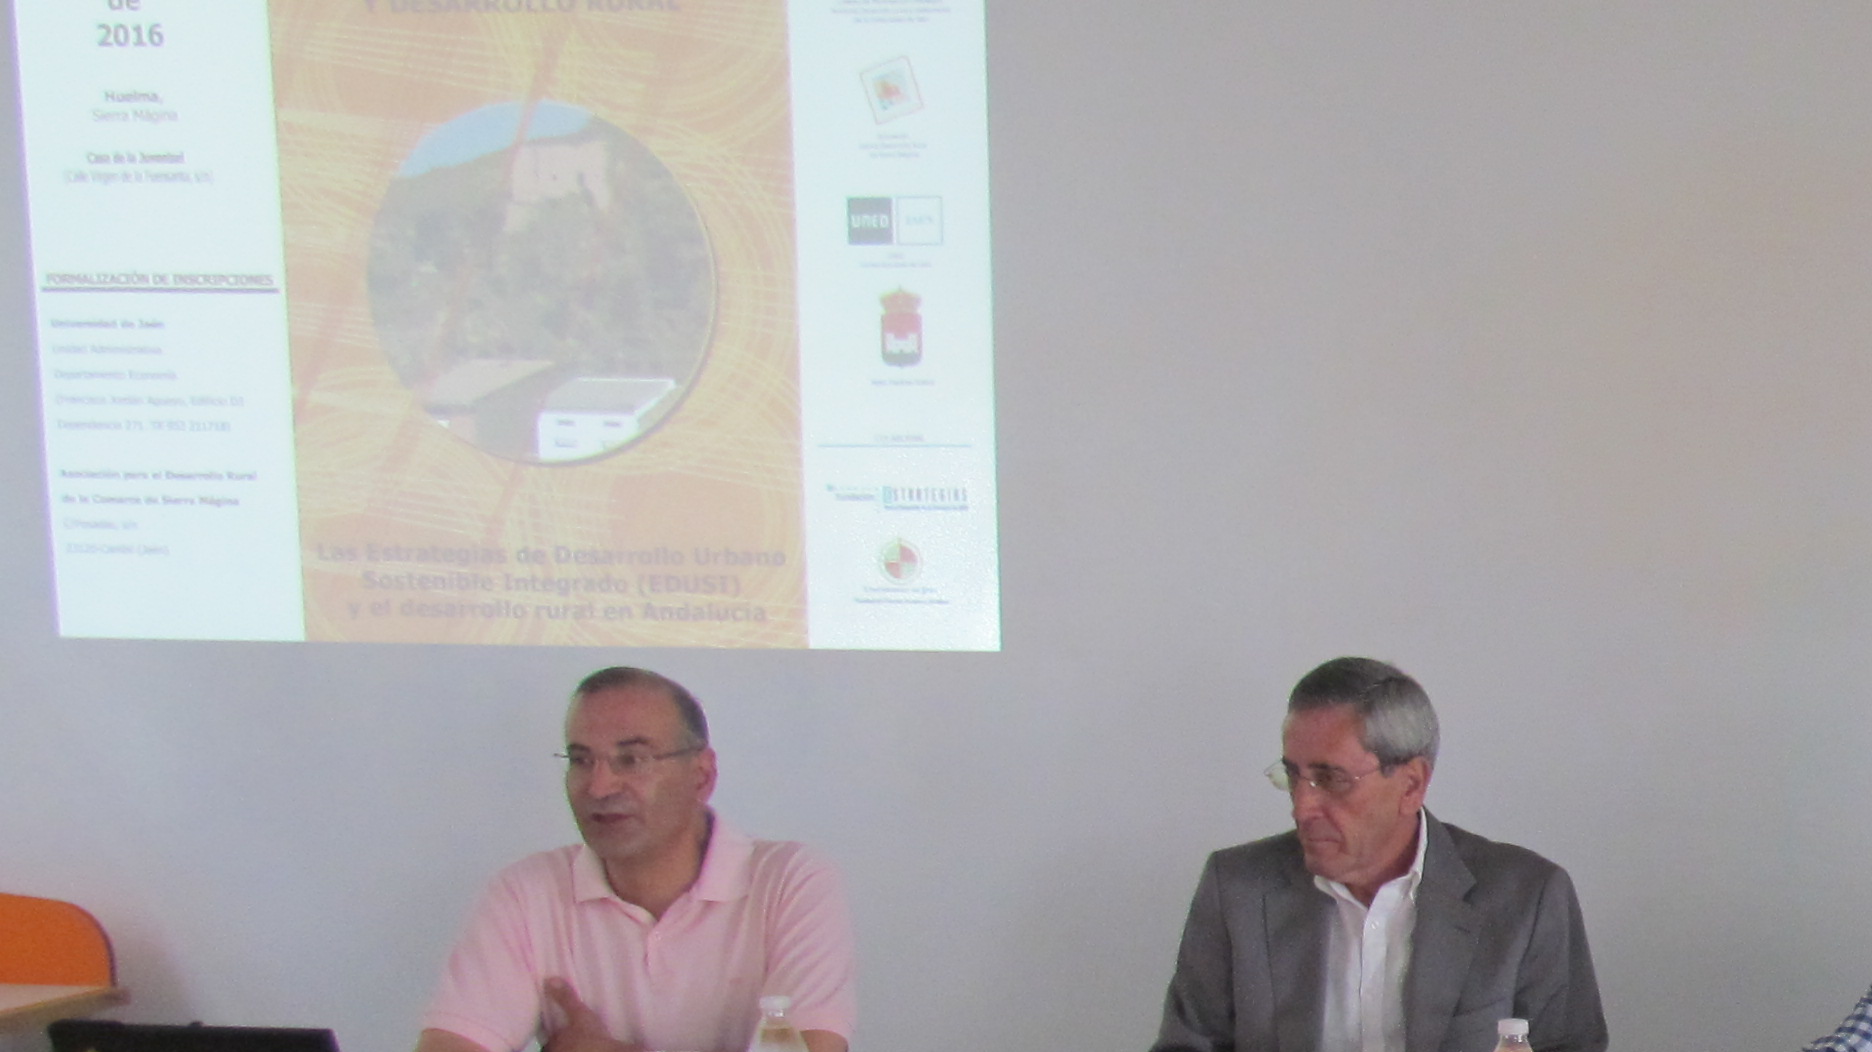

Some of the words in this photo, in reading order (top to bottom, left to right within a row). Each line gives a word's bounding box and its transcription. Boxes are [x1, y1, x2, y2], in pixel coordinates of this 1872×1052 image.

[97, 23, 164, 47] 2016
[317, 543, 358, 563] Las
[365, 543, 507, 567] Estrategias
[517, 546, 546, 564] de
[554, 545, 684, 567] Desarrollo
[694, 548, 786, 567] Urbano
[362, 572, 493, 592] Sostenible
[504, 573, 628, 596] Integrado
[400, 599, 527, 619] desarrollo
[535, 600, 592, 621] rural
[604, 604, 632, 621] en
